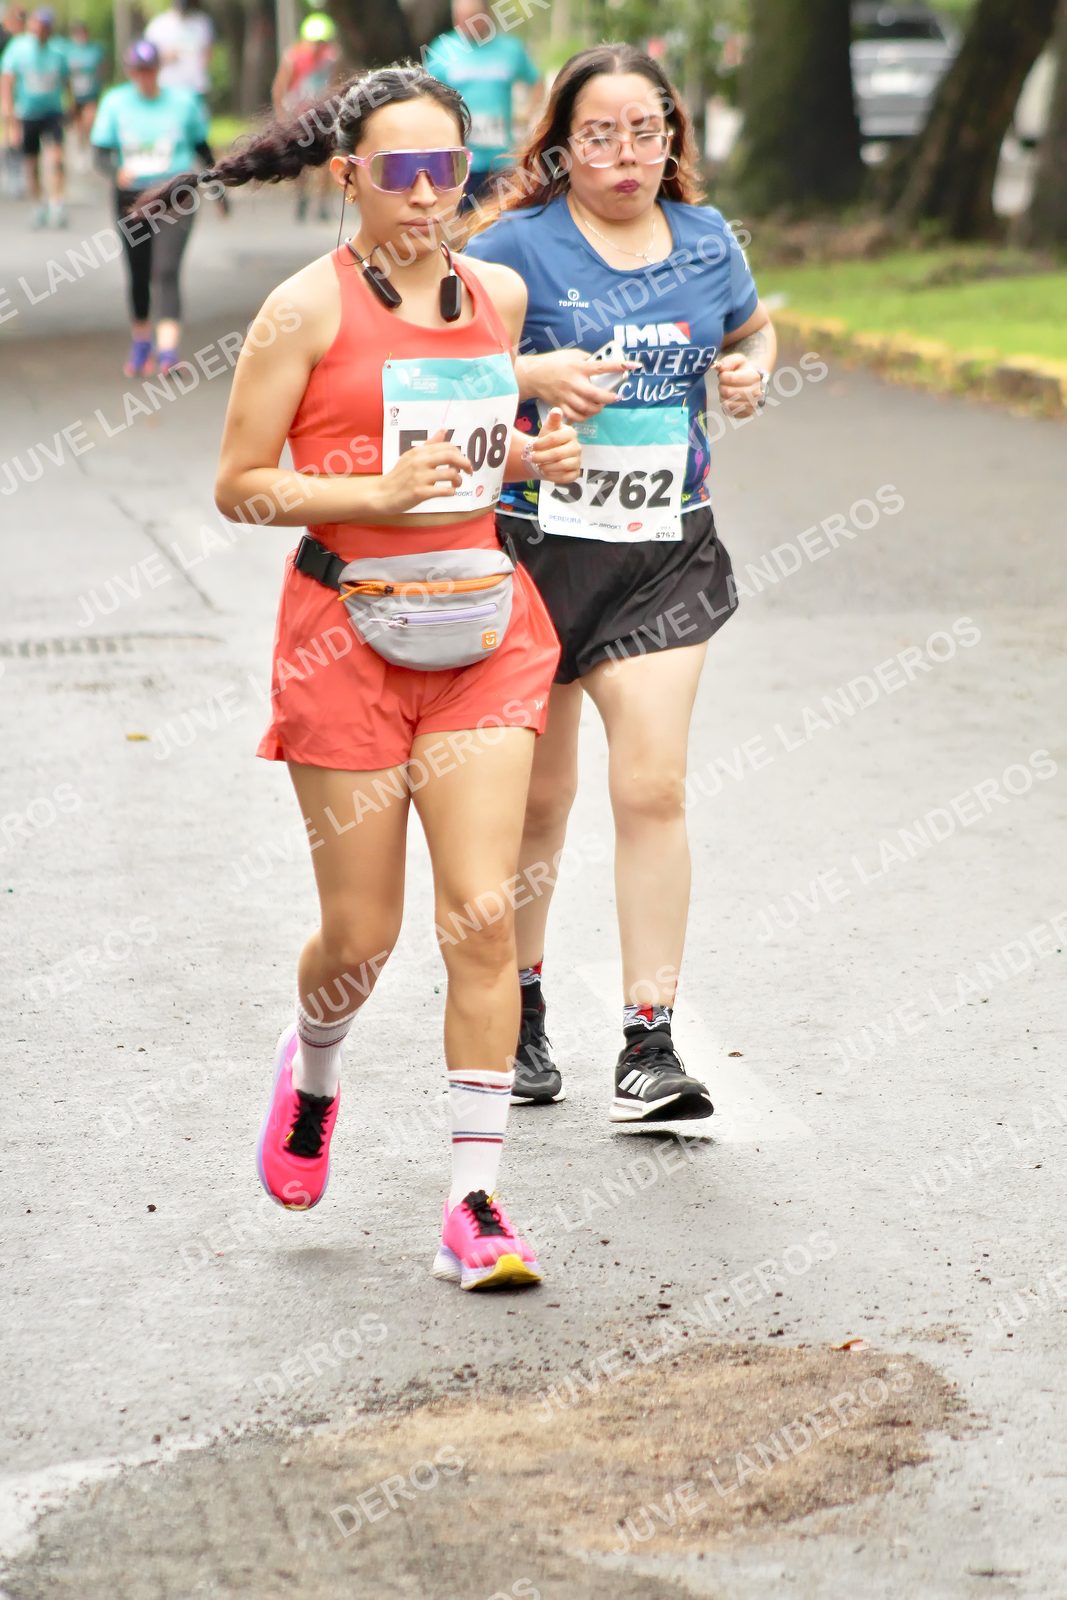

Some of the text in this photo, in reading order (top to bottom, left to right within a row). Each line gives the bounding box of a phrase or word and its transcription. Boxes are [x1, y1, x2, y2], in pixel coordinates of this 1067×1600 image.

[558, 300, 589, 309] TOPTIME
[628, 346, 717, 376] NERS
[550, 468, 674, 510] 5762
